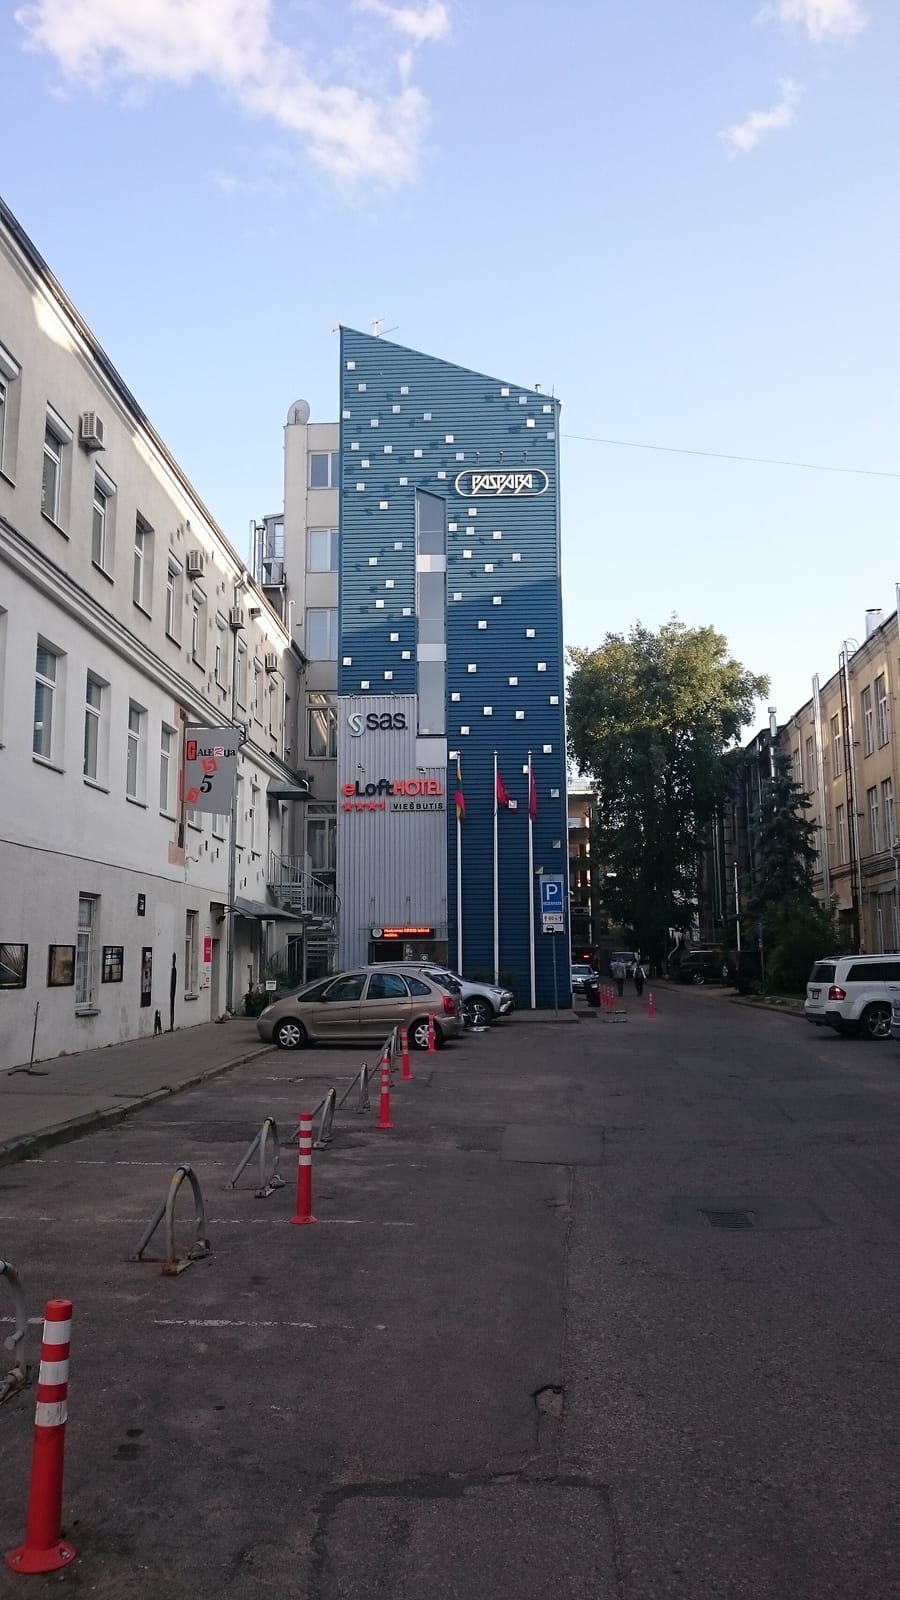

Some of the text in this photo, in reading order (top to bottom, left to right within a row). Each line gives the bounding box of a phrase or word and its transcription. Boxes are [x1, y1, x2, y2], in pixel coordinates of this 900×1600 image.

[200, 773, 214, 793] 5
[393, 801, 444, 810] VIEŠBUTIS
[546, 883, 558, 901] P
